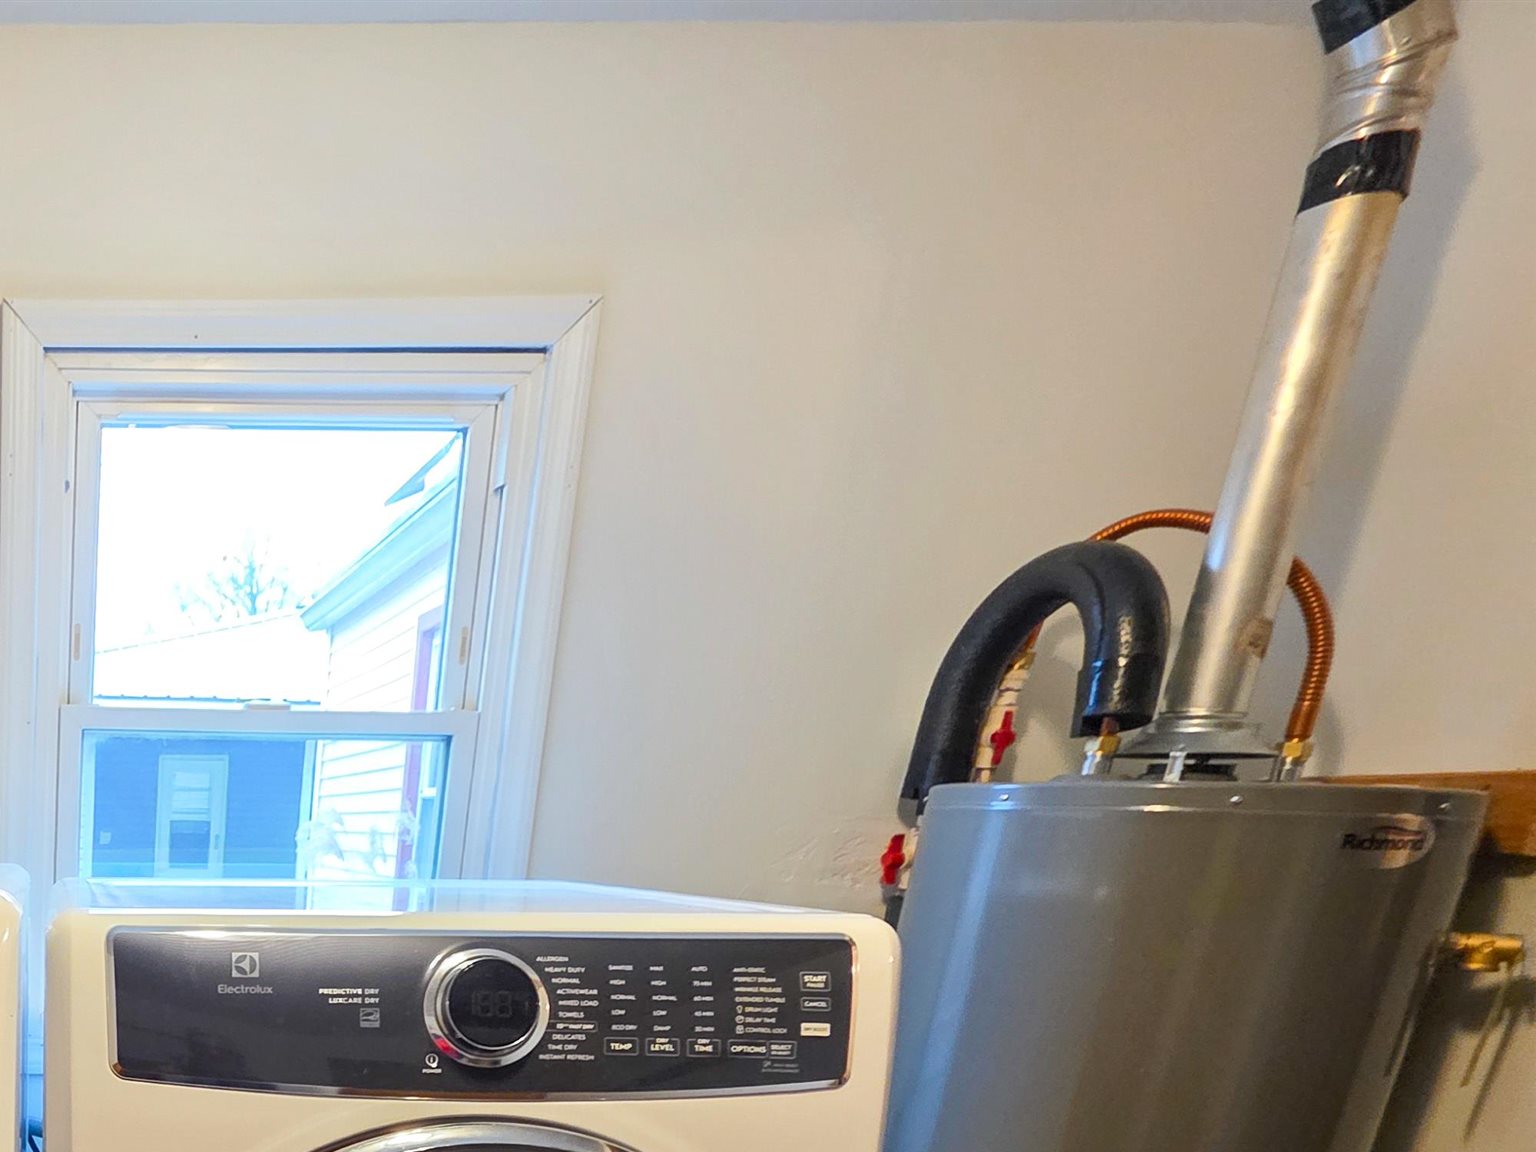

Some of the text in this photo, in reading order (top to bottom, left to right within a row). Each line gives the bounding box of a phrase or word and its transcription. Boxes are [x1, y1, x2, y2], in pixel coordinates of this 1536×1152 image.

[217, 984, 273, 994] Electrolux
[650, 1043, 675, 1051] LEVEL
[694, 1044, 713, 1052] TIME
[730, 1045, 767, 1053] OPTIONS
